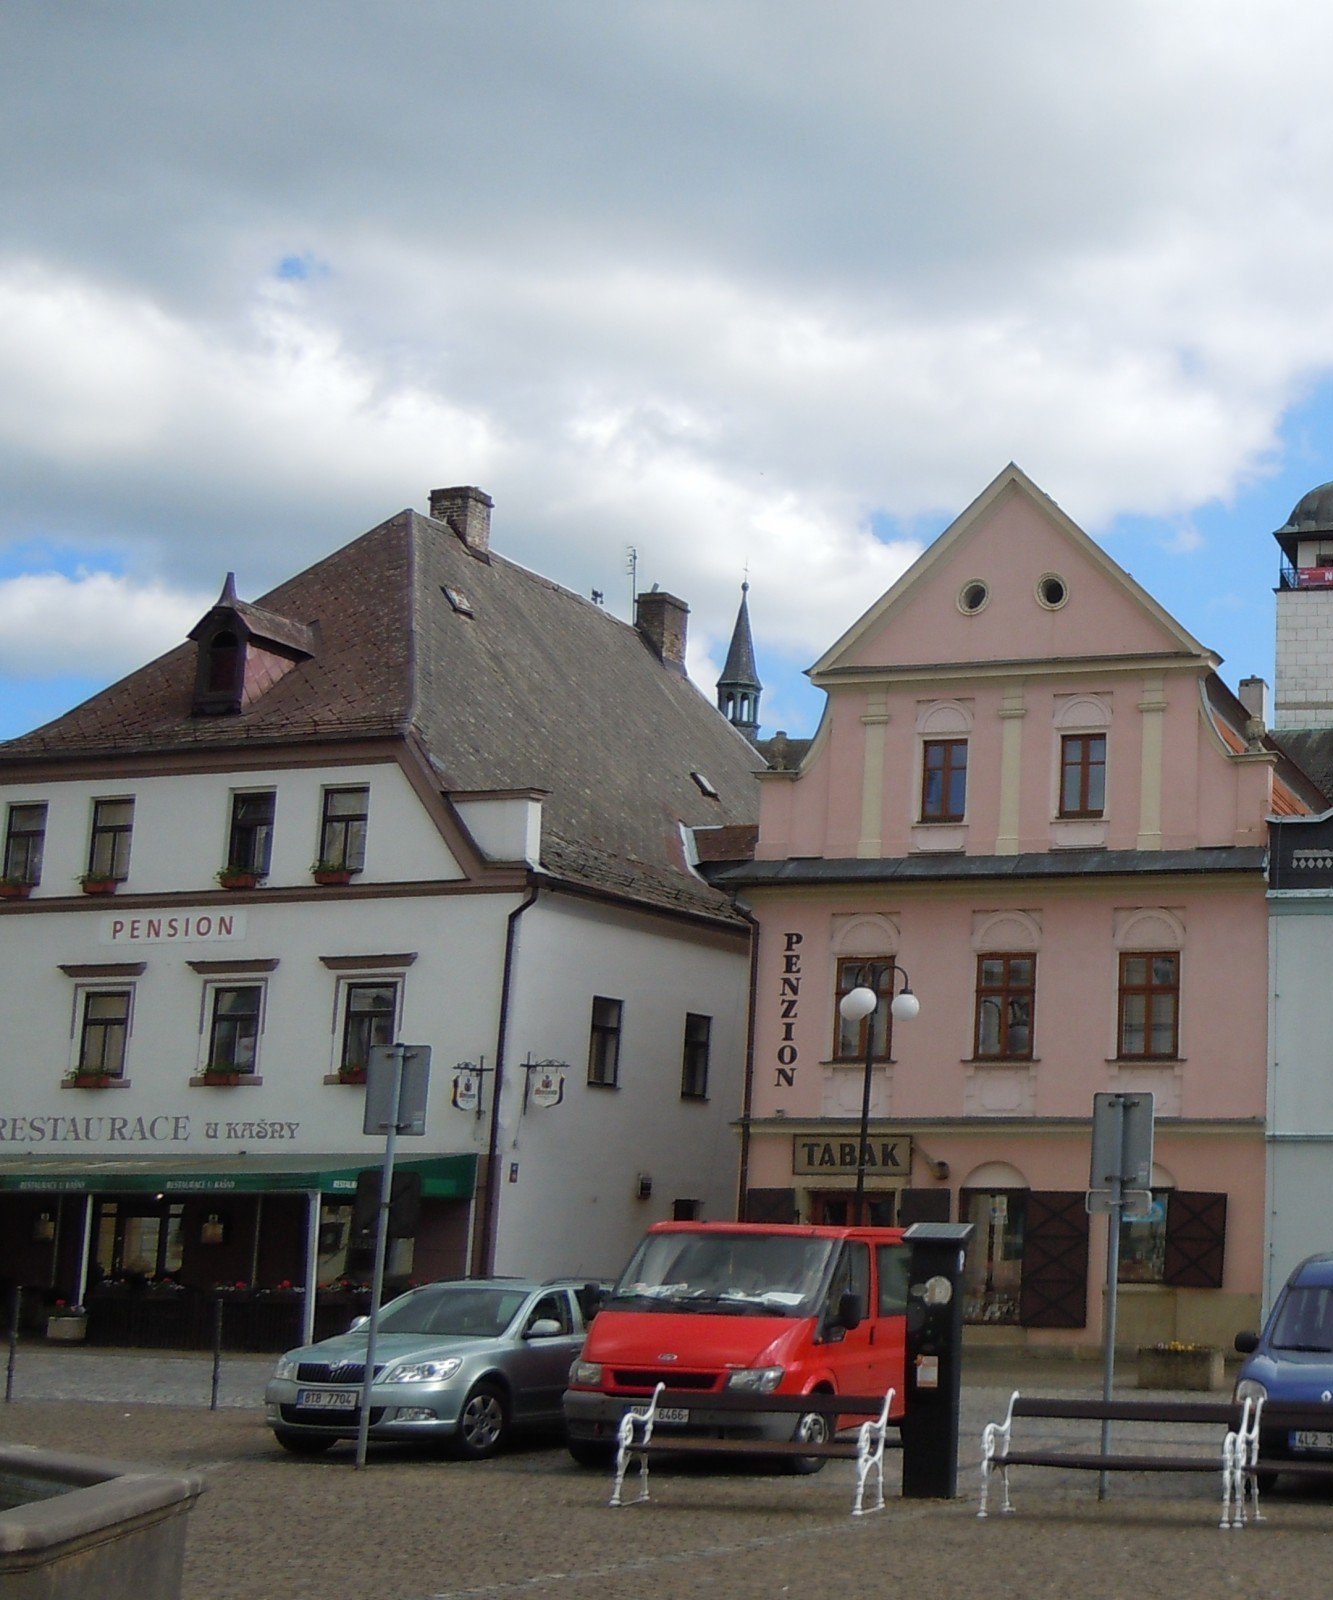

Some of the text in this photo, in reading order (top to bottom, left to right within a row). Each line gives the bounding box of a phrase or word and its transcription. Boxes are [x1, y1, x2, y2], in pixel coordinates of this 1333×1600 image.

[112, 916, 234, 940] PENSION
[774, 932, 804, 1087] PENZION
[0, 1115, 190, 1141] RESTAURACE
[802, 1142, 899, 1167] TABAK
[658, 1409, 684, 1420] 6466
[1298, 1433, 1318, 1446] 4L2
